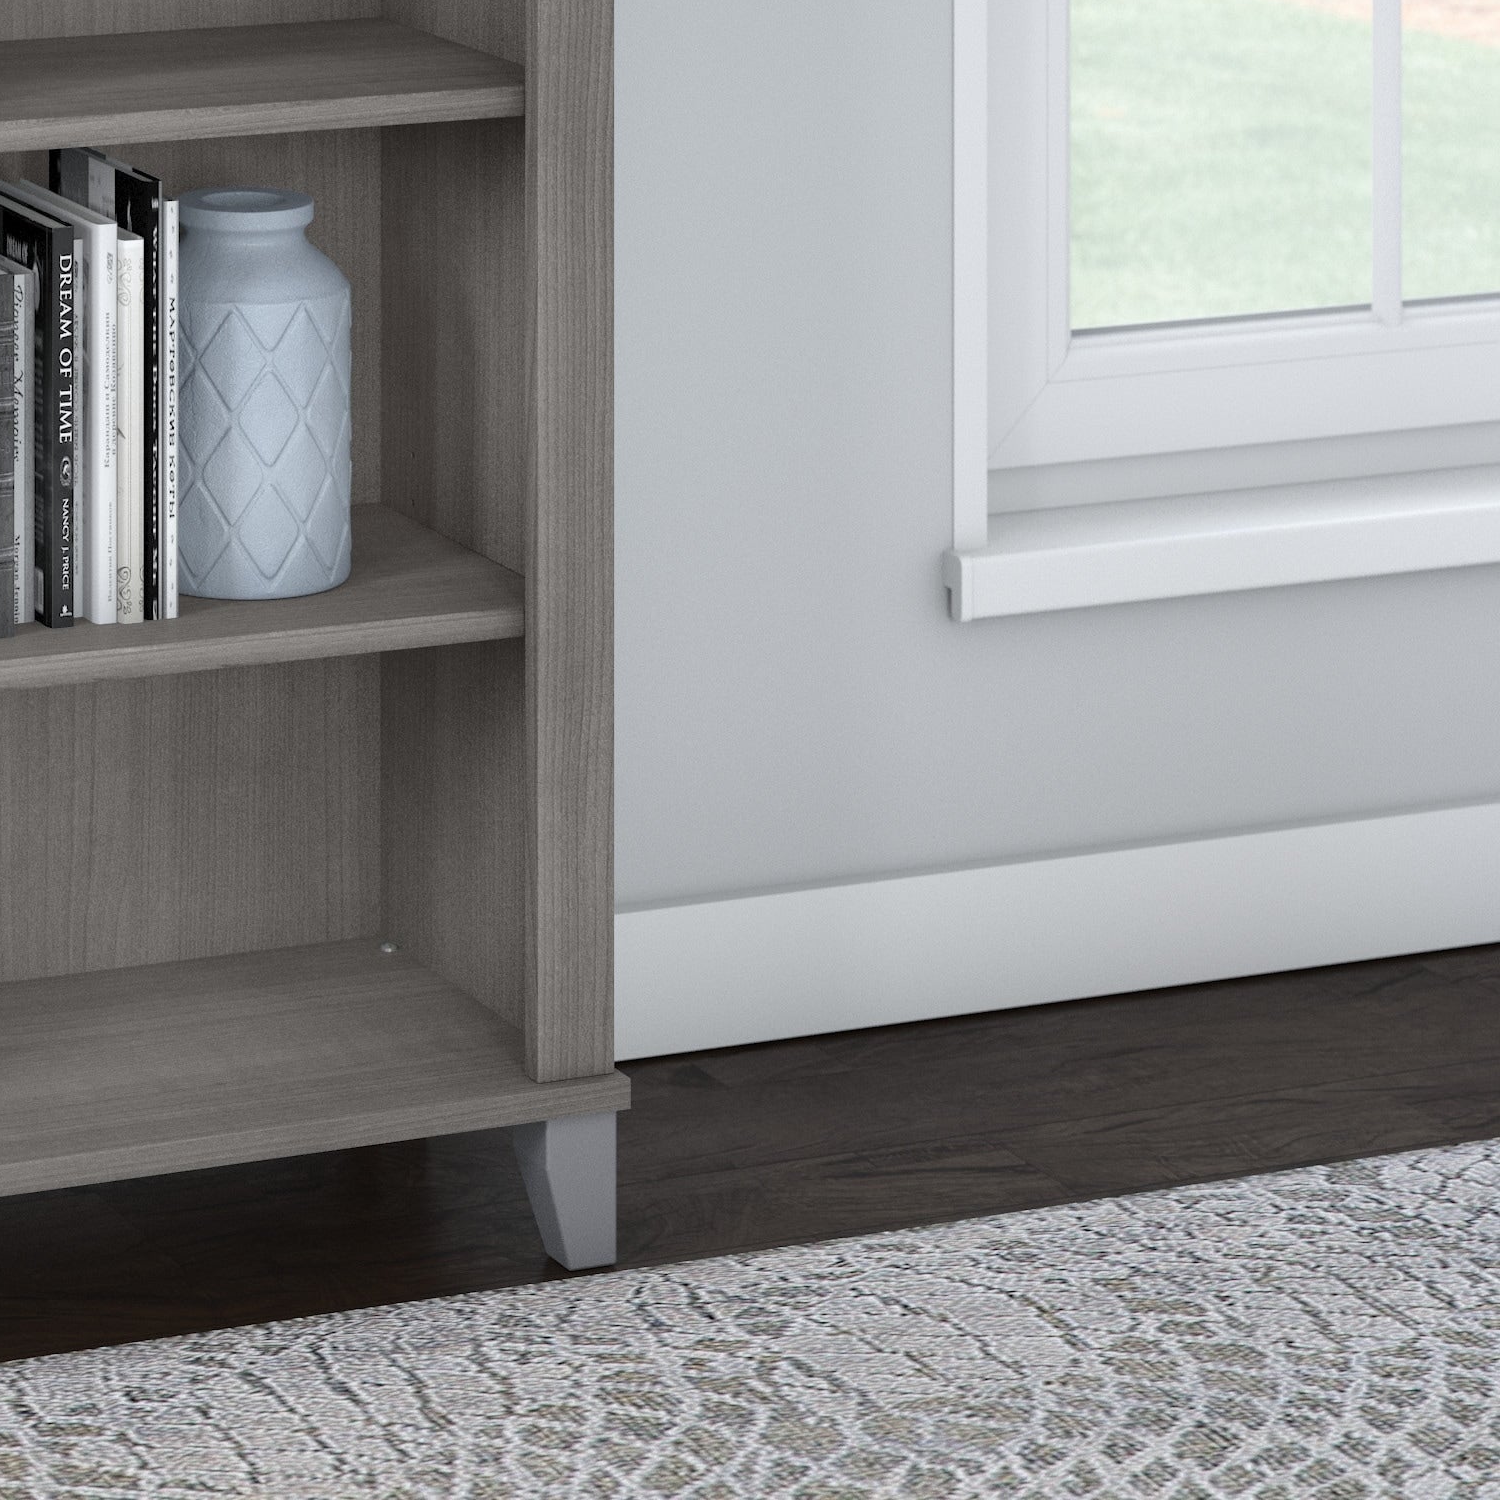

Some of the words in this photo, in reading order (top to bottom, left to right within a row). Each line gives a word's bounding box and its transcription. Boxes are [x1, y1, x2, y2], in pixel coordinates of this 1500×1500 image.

[59, 253, 72, 340] DREAM
[59, 348, 72, 378] OF
[59, 386, 72, 444] TIME
[62, 498, 70, 542] NANCY
[61, 546, 70, 554] J.
